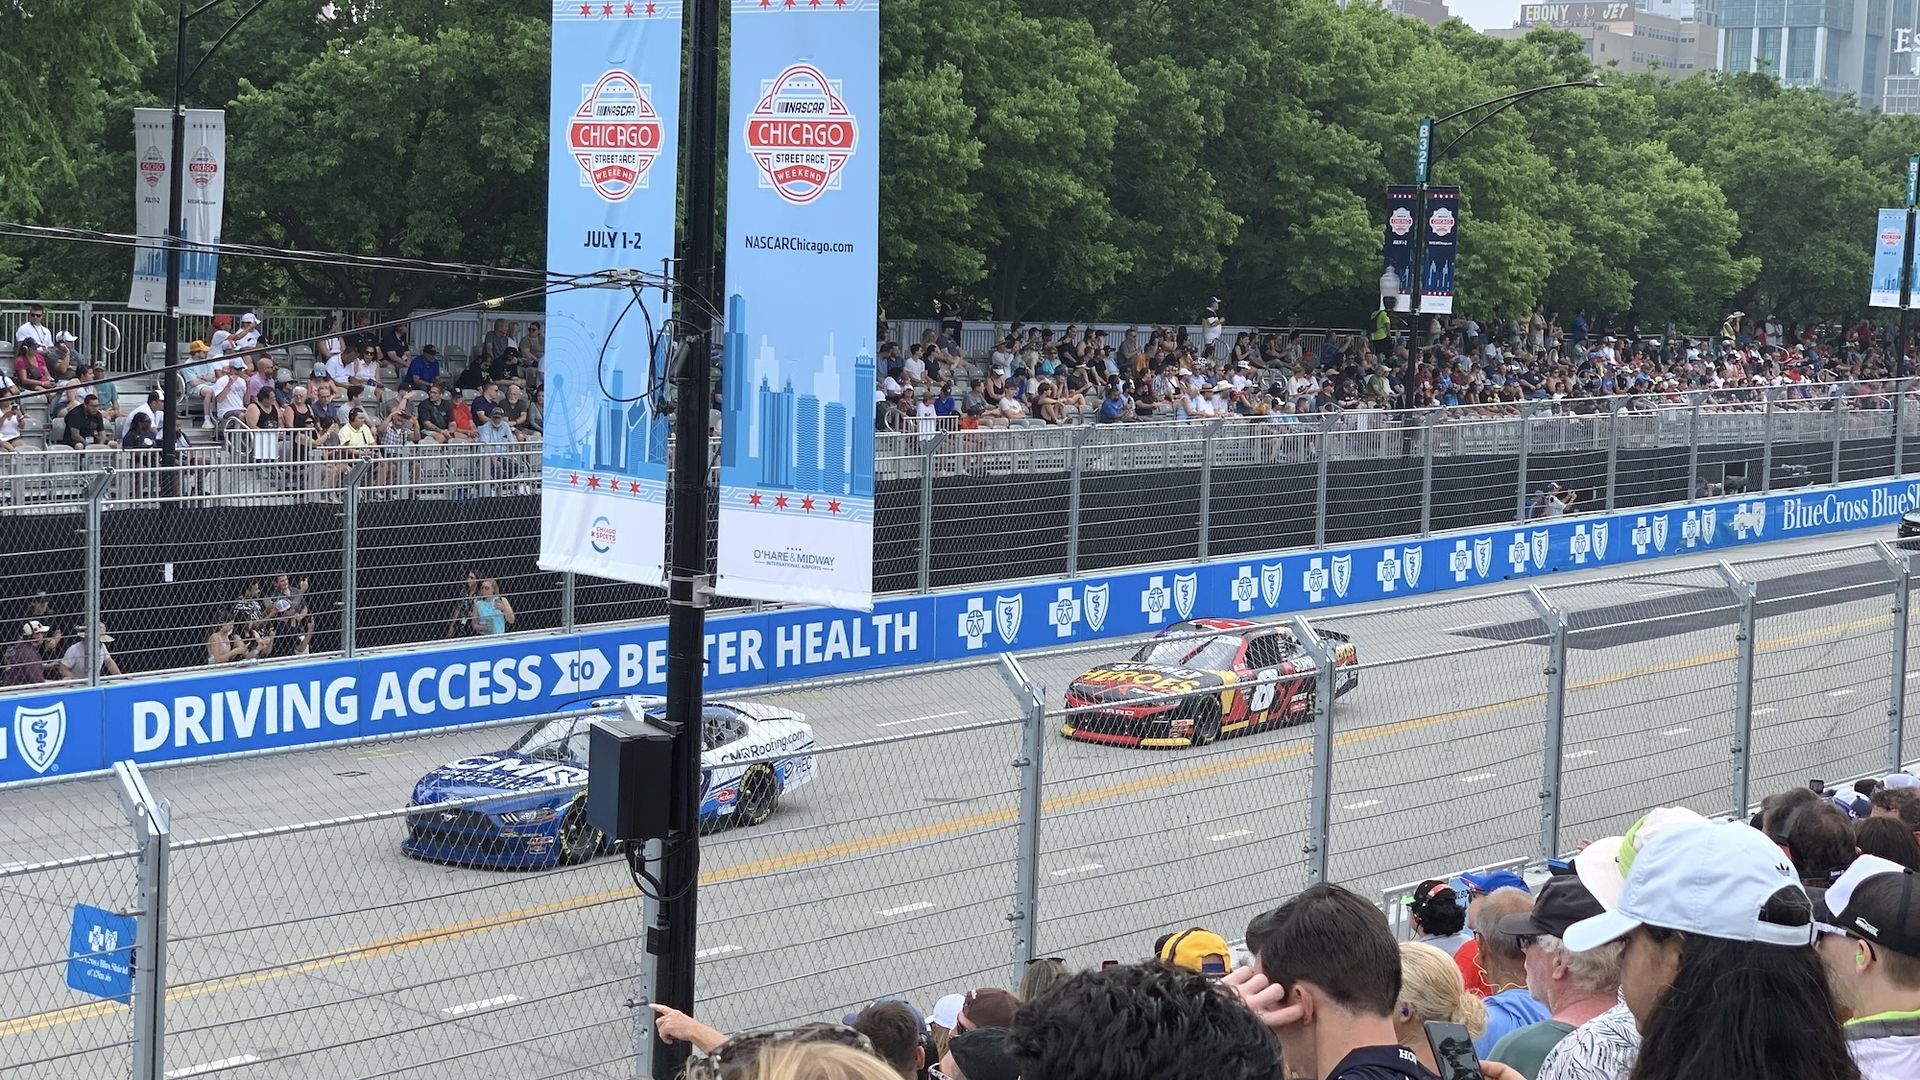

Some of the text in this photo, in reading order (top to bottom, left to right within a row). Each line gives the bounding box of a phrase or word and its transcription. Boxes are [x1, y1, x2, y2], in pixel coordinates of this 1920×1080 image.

[1526, 5, 1570, 21] EBONY
[1603, 3, 1629, 19] JET
[605, 105, 636, 116] NASCAR
[787, 102, 826, 114] NASCAR
[579, 125, 652, 147] CHICAGO
[758, 123, 844, 146] CHICAGO
[594, 155, 636, 164] STREET RACE
[776, 154, 826, 165] STREET RACE
[1418, 125, 1430, 176] B321
[595, 168, 634, 181] WEEKEND
[777, 168, 822, 182] WEEKEND
[584, 230, 642, 250] JULY 1-2
[745, 235, 854, 255] NASCARChicago.com
[1782, 483, 1920, 530] BlueCross BlueS
[753, 549, 835, 567] O'HARE & MIDWAY
[133, 676, 358, 753] DRIVING
[370, 655, 542, 721] ACCESS
[568, 659, 595, 682] to
[776, 611, 918, 668] HEALTH
[1250, 668, 1279, 713] 8
